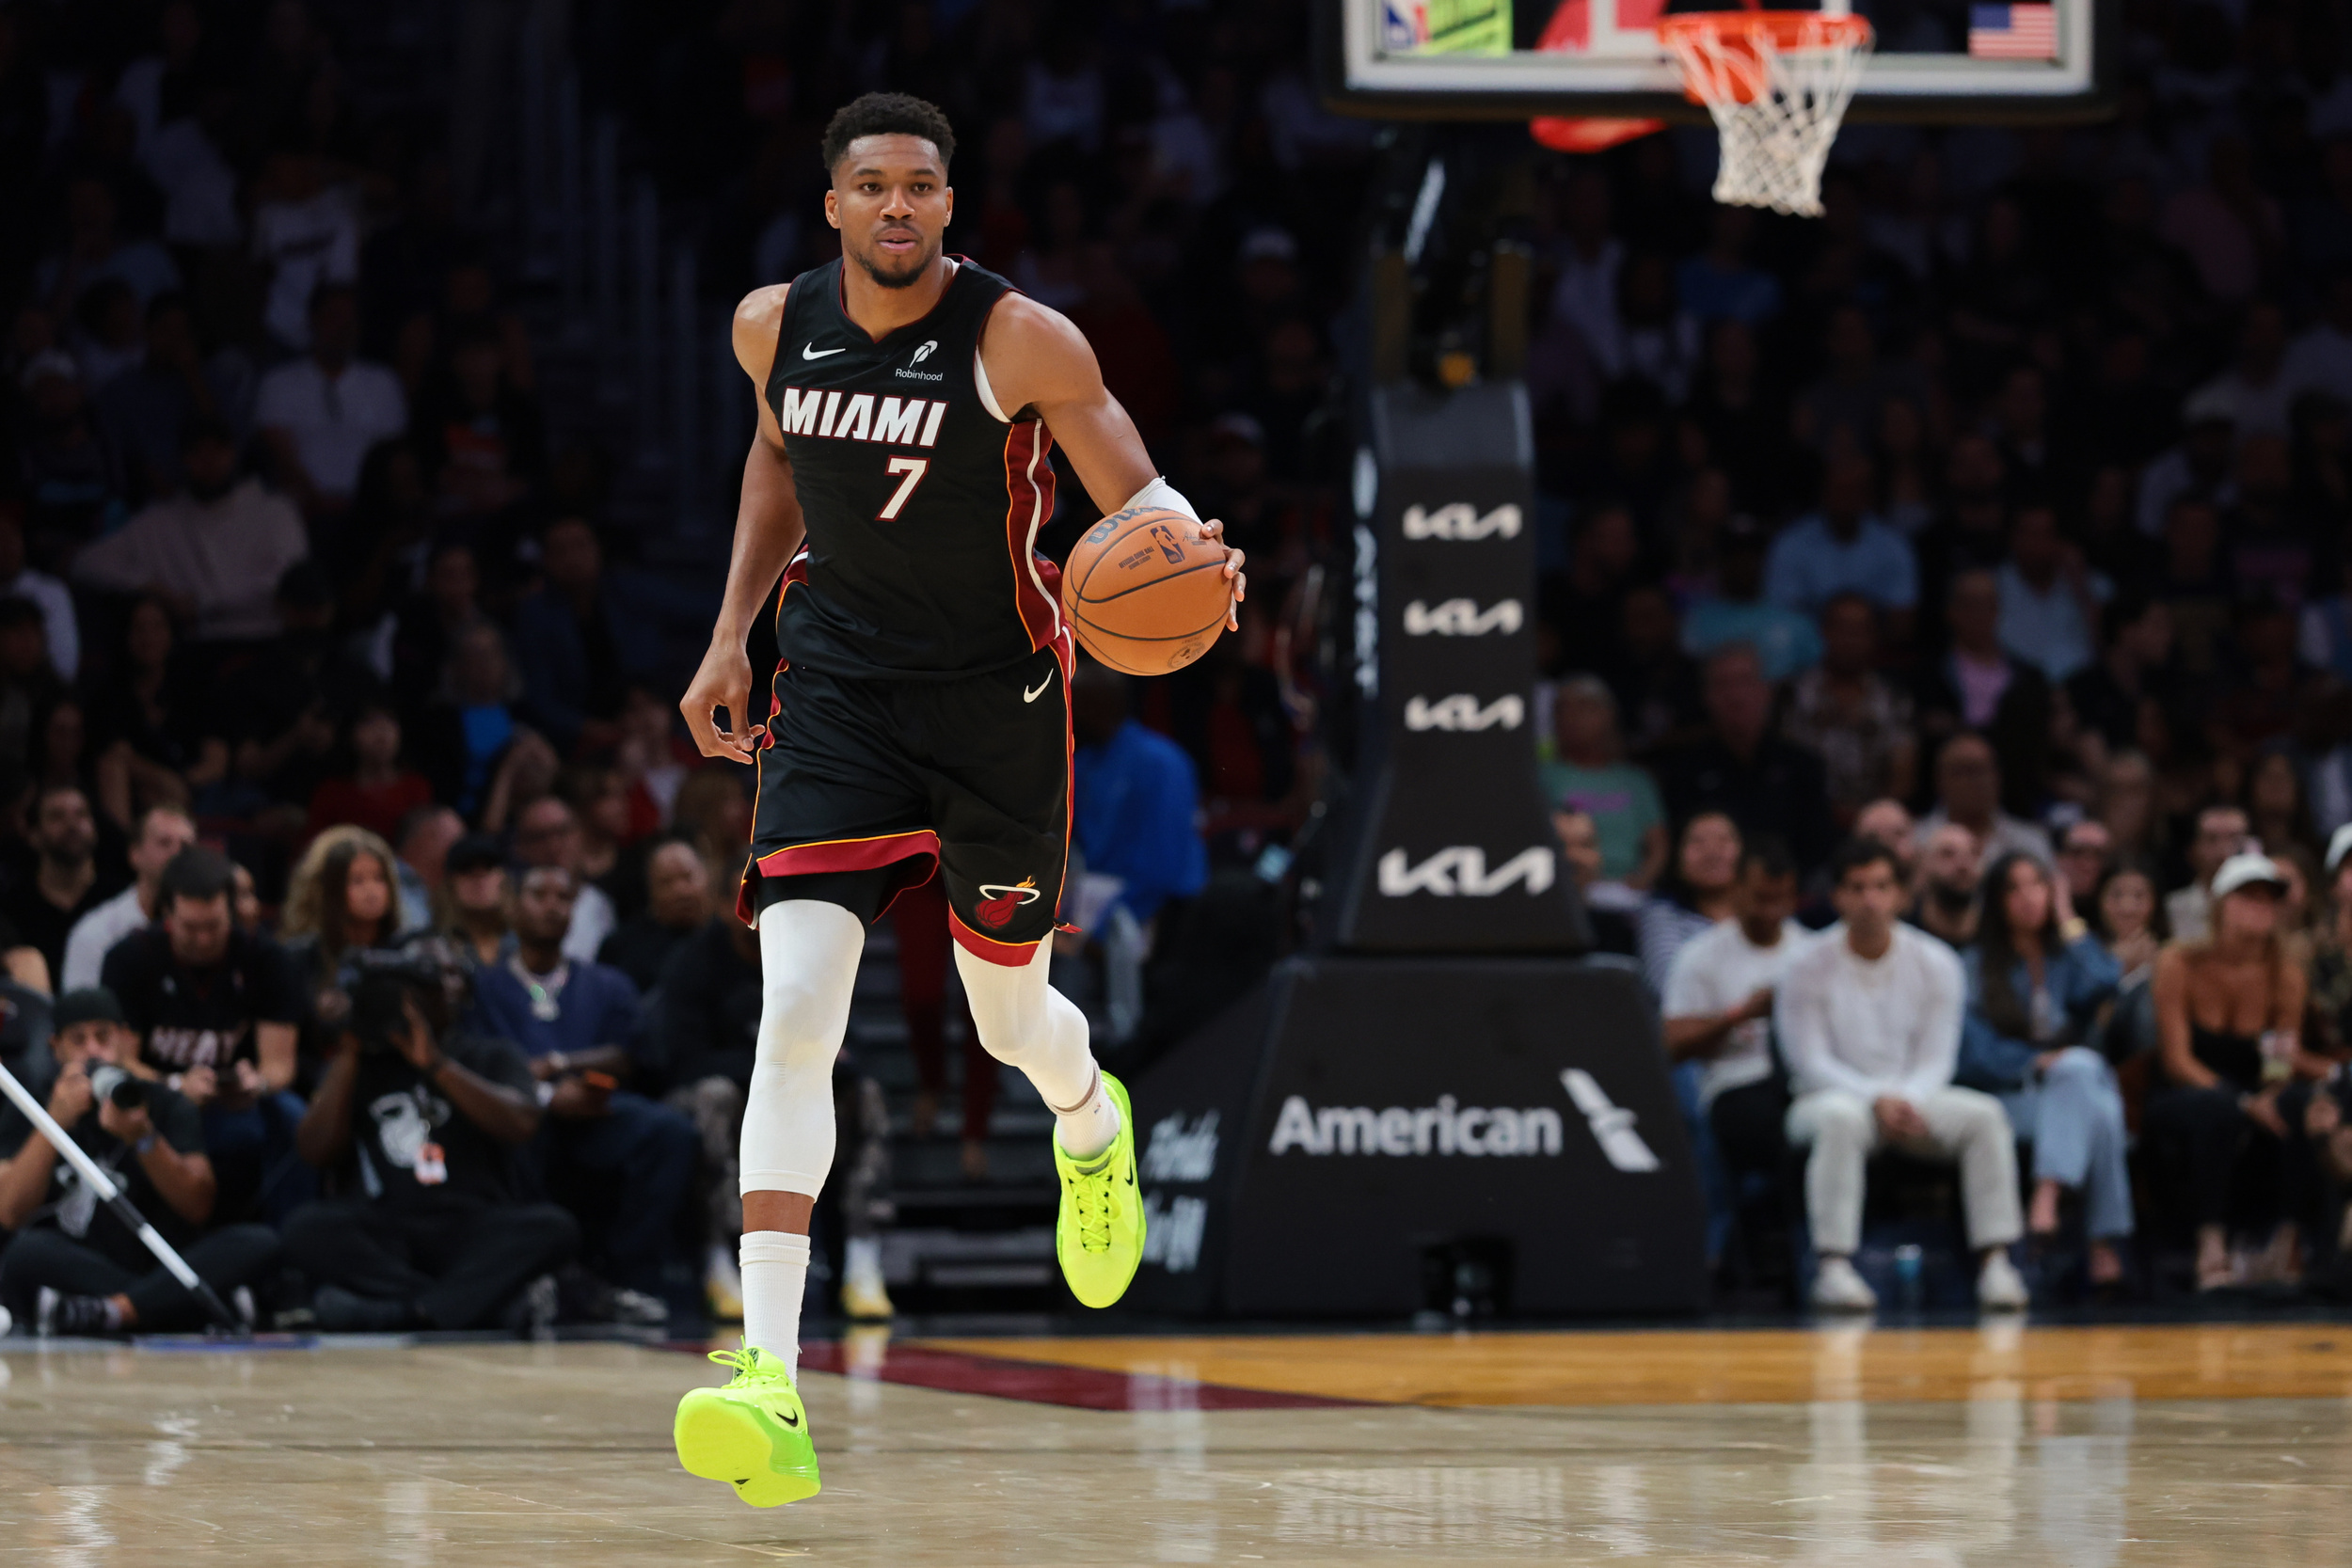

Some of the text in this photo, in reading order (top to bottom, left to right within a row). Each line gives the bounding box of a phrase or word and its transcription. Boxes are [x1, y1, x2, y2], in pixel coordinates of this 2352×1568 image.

[895, 368, 943, 381] Robinhood
[782, 386, 950, 450] MIAMI
[875, 454, 931, 523] 7
[1404, 504, 1521, 539] KIA
[1405, 599, 1522, 635] KIA
[1406, 695, 1523, 730] KIA
[1379, 847, 1555, 896] KIA
[1270, 1094, 1563, 1155] American
